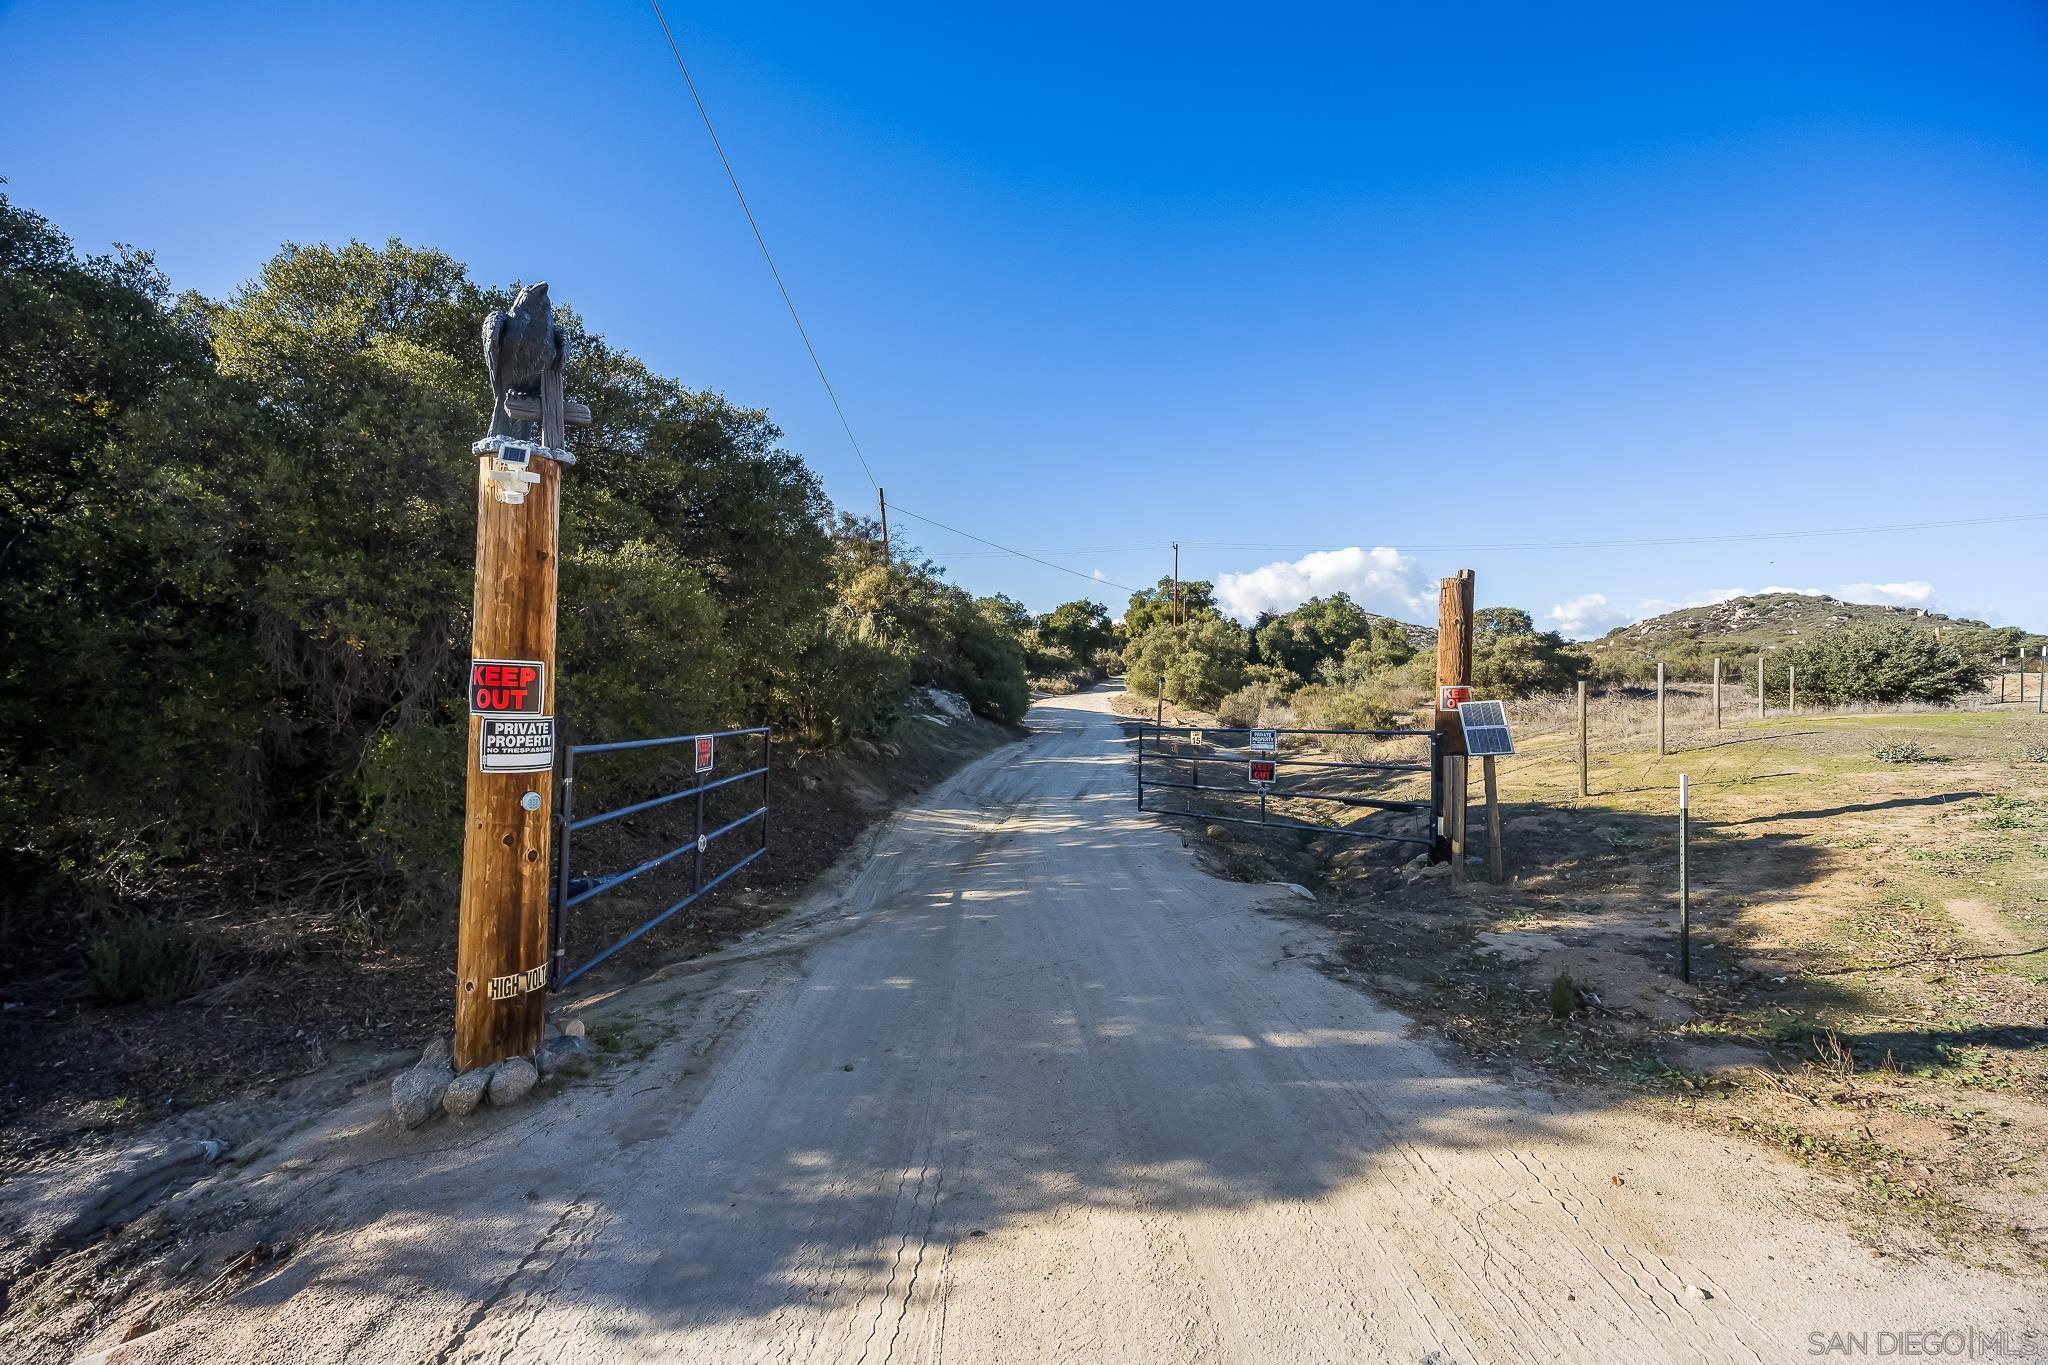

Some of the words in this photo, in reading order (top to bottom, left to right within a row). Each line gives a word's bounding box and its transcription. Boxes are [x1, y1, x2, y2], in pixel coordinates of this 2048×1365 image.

[473, 665, 536, 687] KEEP
[476, 688, 528, 710] OUT
[494, 722, 549, 735] PRIVATE
[487, 734, 552, 747] PROPERTY
[1191, 736, 1201, 745] 15
[501, 746, 552, 754] TRESPASSING
[1252, 763, 1272, 771] KEEP
[1254, 771, 1271, 780] OUT
[491, 974, 519, 999] HIGH
